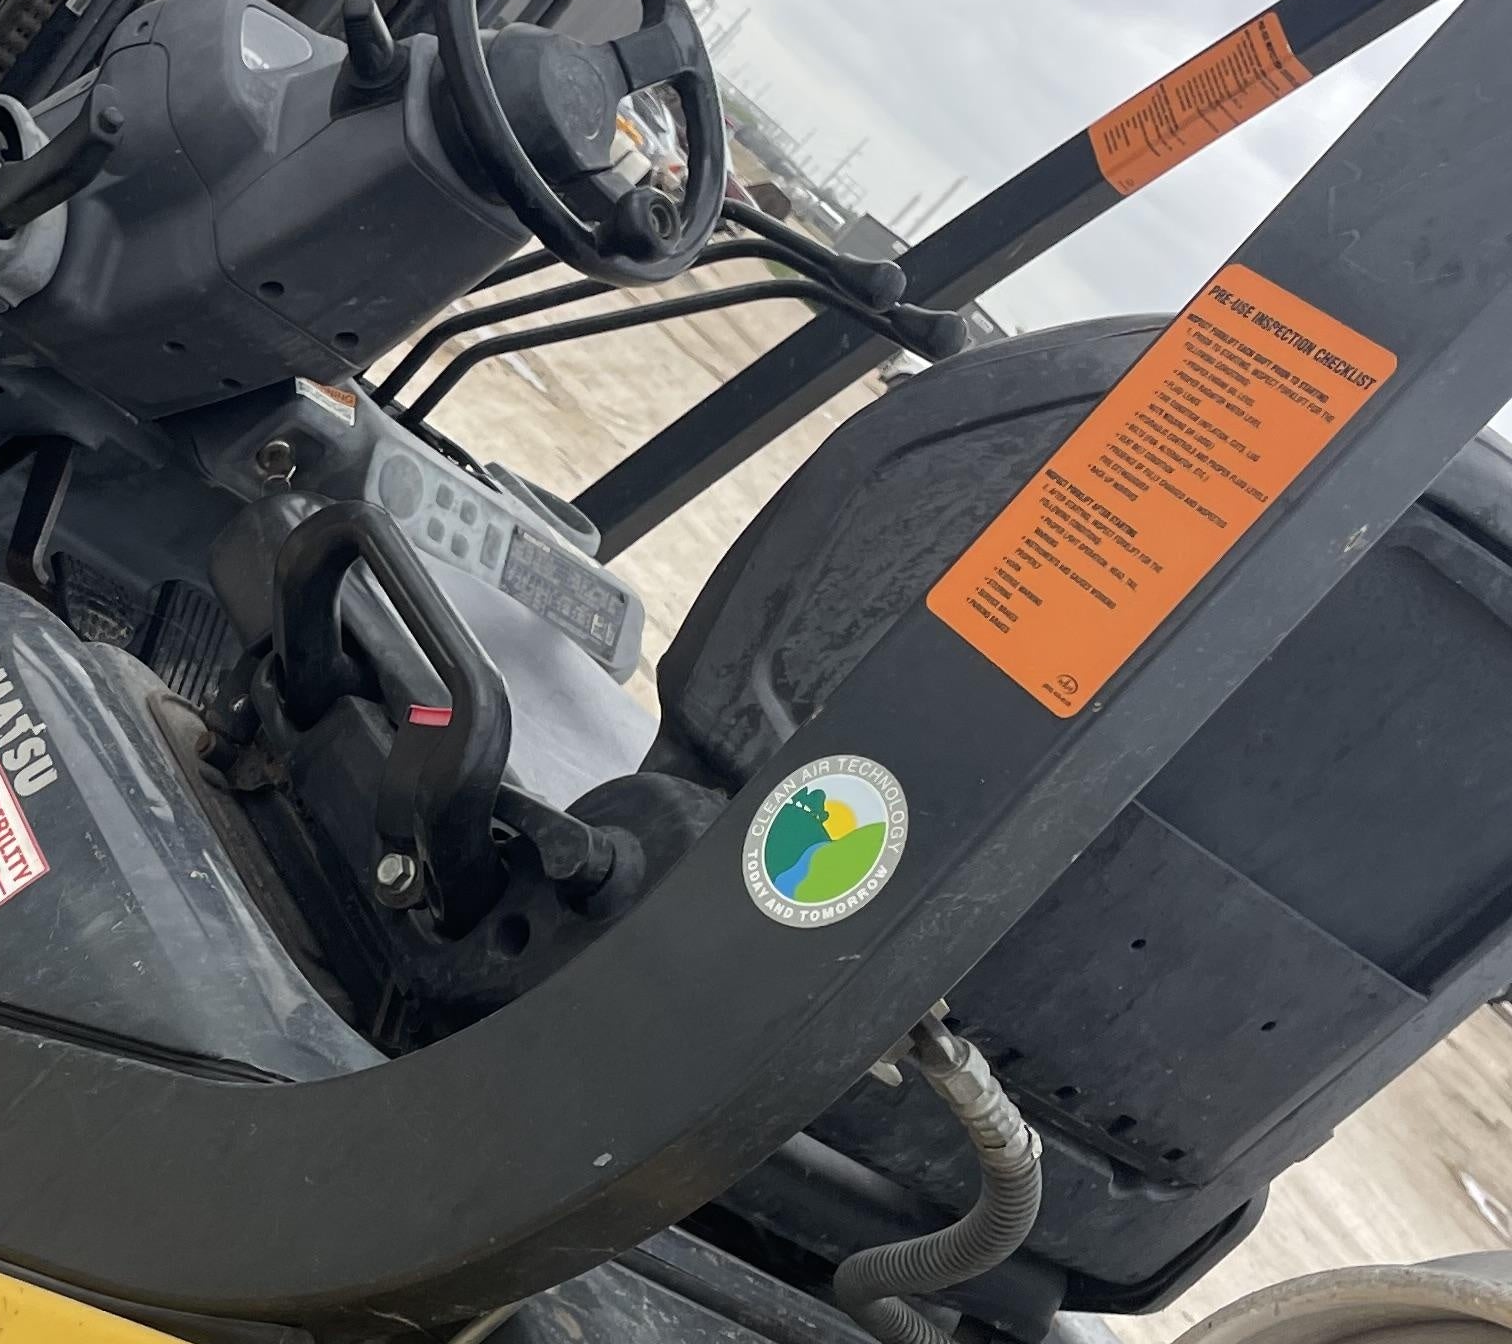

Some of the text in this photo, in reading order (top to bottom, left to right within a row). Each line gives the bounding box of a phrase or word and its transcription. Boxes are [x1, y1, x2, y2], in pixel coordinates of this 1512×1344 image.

[1206, 284, 1378, 391] PRE-USE INSPECTION CHECKLIST
[752, 758, 905, 853] CLEAN AIR TECHNOLOGY
[748, 848, 888, 921] TODAY AND TOMORROW
